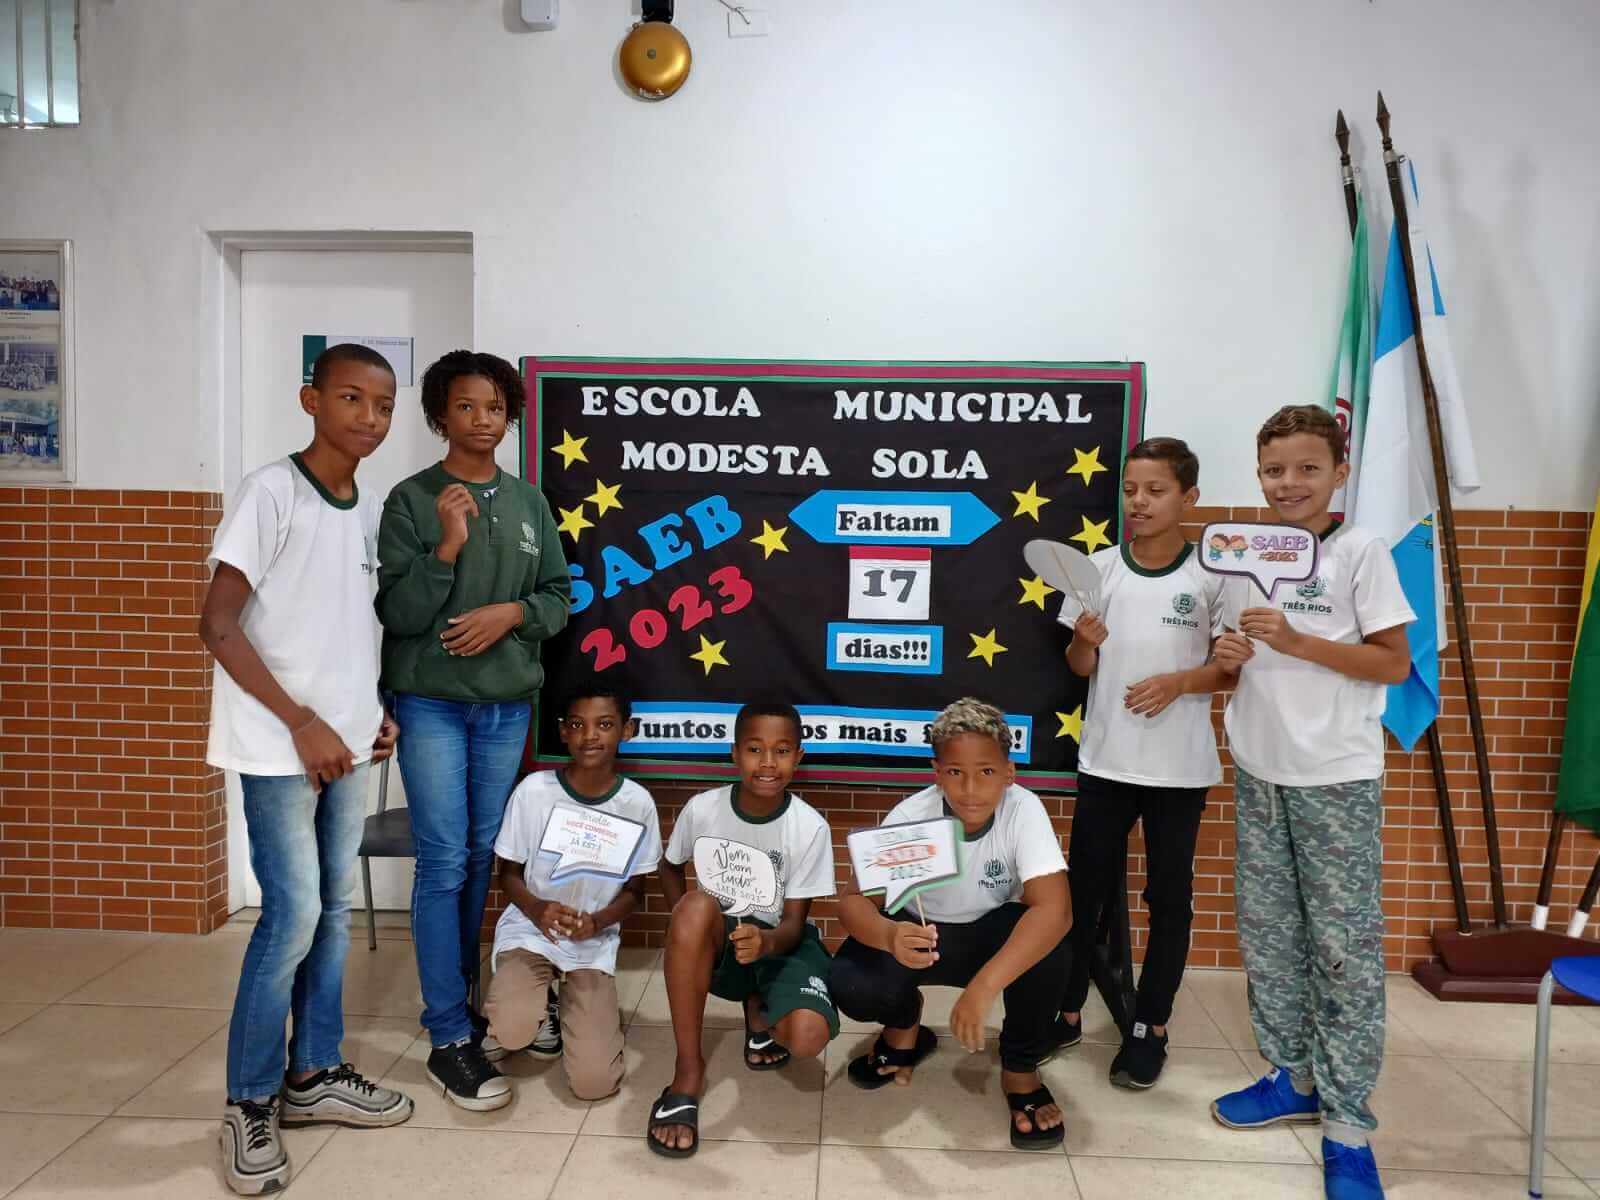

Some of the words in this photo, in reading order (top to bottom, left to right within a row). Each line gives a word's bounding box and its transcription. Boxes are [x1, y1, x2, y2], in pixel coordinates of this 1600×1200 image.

[581, 386, 761, 417] ESCOLA
[833, 390, 1093, 424] MUNICIPAL
[620, 441, 830, 476] MODESTA
[871, 448, 989, 480] SOLA
[838, 511, 939, 532] Faltam
[567, 495, 742, 614] SAEB
[1251, 535, 1309, 550] SAEB
[862, 569, 917, 603] 17
[580, 565, 753, 673] 2023
[1283, 601, 1305, 610] TRÊS
[1307, 603, 1332, 613] RIOS
[845, 638, 928, 660] dias!!!
[631, 717, 727, 739] Juntos
[839, 722, 907, 743] mais
